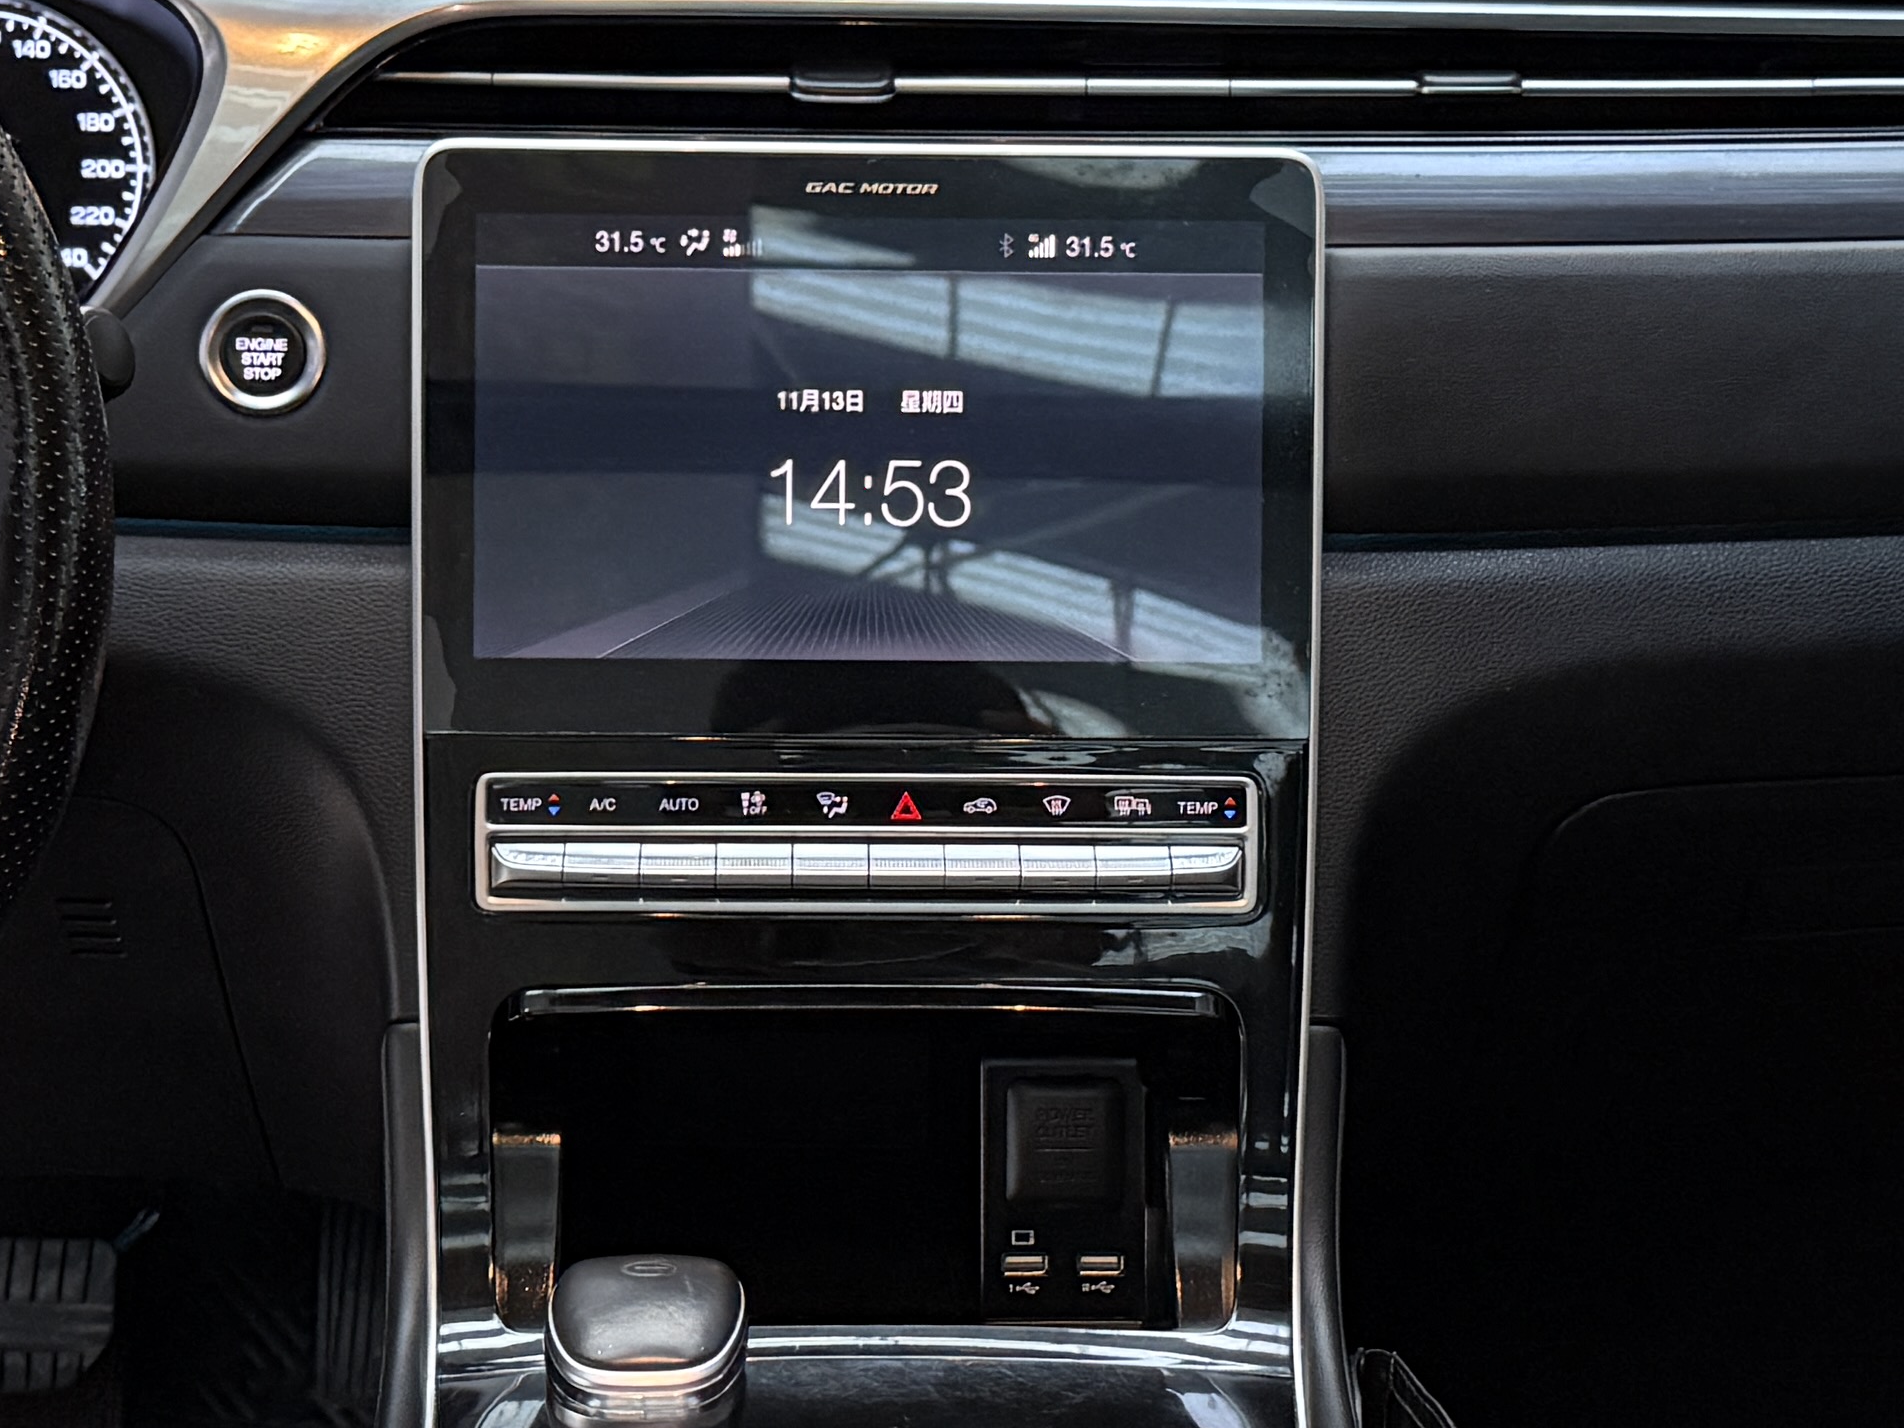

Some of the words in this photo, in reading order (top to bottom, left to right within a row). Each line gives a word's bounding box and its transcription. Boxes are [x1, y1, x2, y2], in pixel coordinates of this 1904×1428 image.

[12, 40, 52, 60] 140
[48, 70, 87, 90] 160
[76, 112, 116, 133] 180
[80, 159, 126, 180] 200
[804, 182, 855, 195] GAC
[859, 183, 940, 196] MOTOR
[70, 205, 116, 226] 220
[594, 230, 645, 253] 31.5
[1065, 235, 1115, 258] 31.5
[60, 247, 90, 268] 40
[235, 337, 289, 352] ENGINE
[241, 352, 285, 367] START
[243, 367, 283, 381] STOP
[777, 389, 864, 413] 11月13日
[900, 390, 964, 414] 星期四
[770, 458, 972, 528] 14:53
[500, 797, 543, 812] TEMP
[589, 797, 617, 812] A/C
[658, 797, 699, 812] AUTO
[1177, 801, 1218, 816] TEMP
